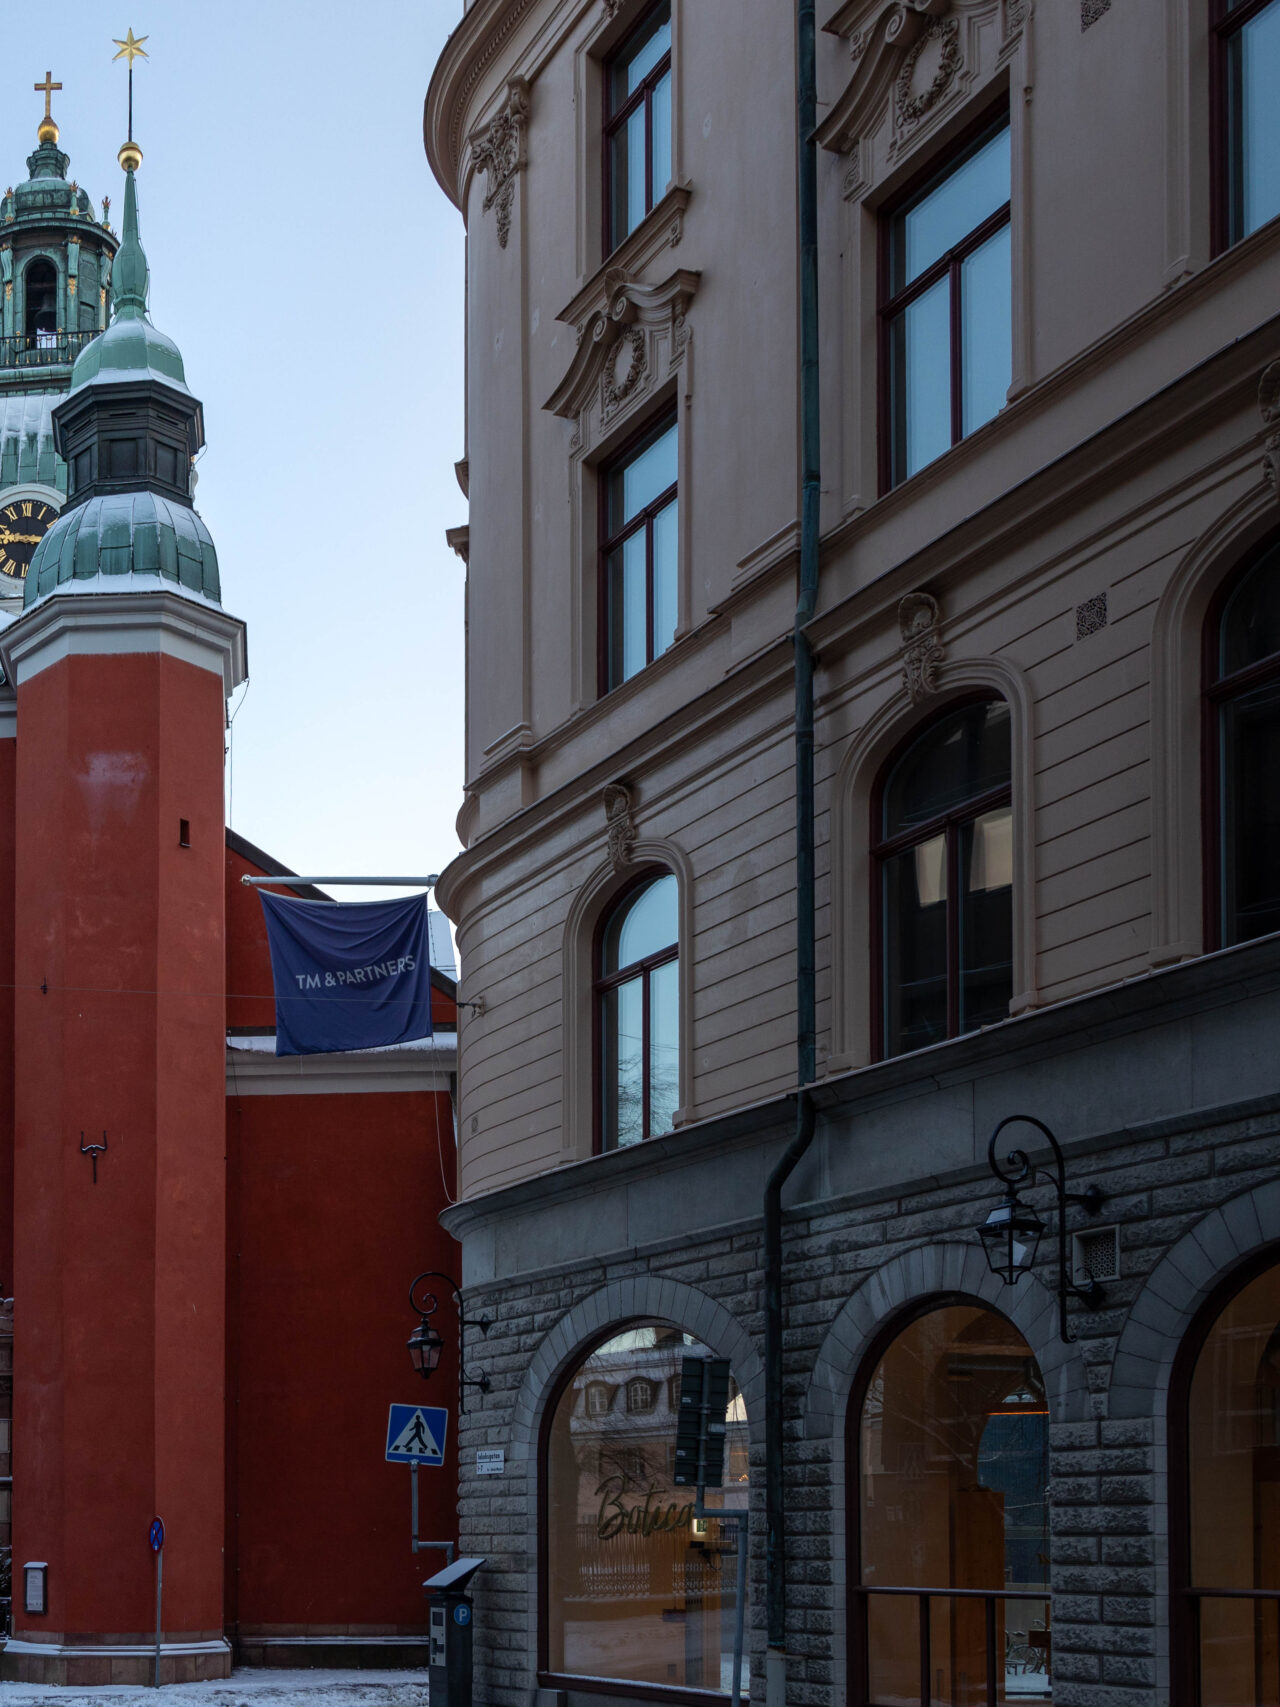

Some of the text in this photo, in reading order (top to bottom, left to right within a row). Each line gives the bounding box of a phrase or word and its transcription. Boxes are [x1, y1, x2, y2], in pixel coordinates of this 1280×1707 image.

[21, 503, 33, 518] XII
[295, 954, 417, 990] TM & PARTNERS
[459, 1608, 468, 1622] P
